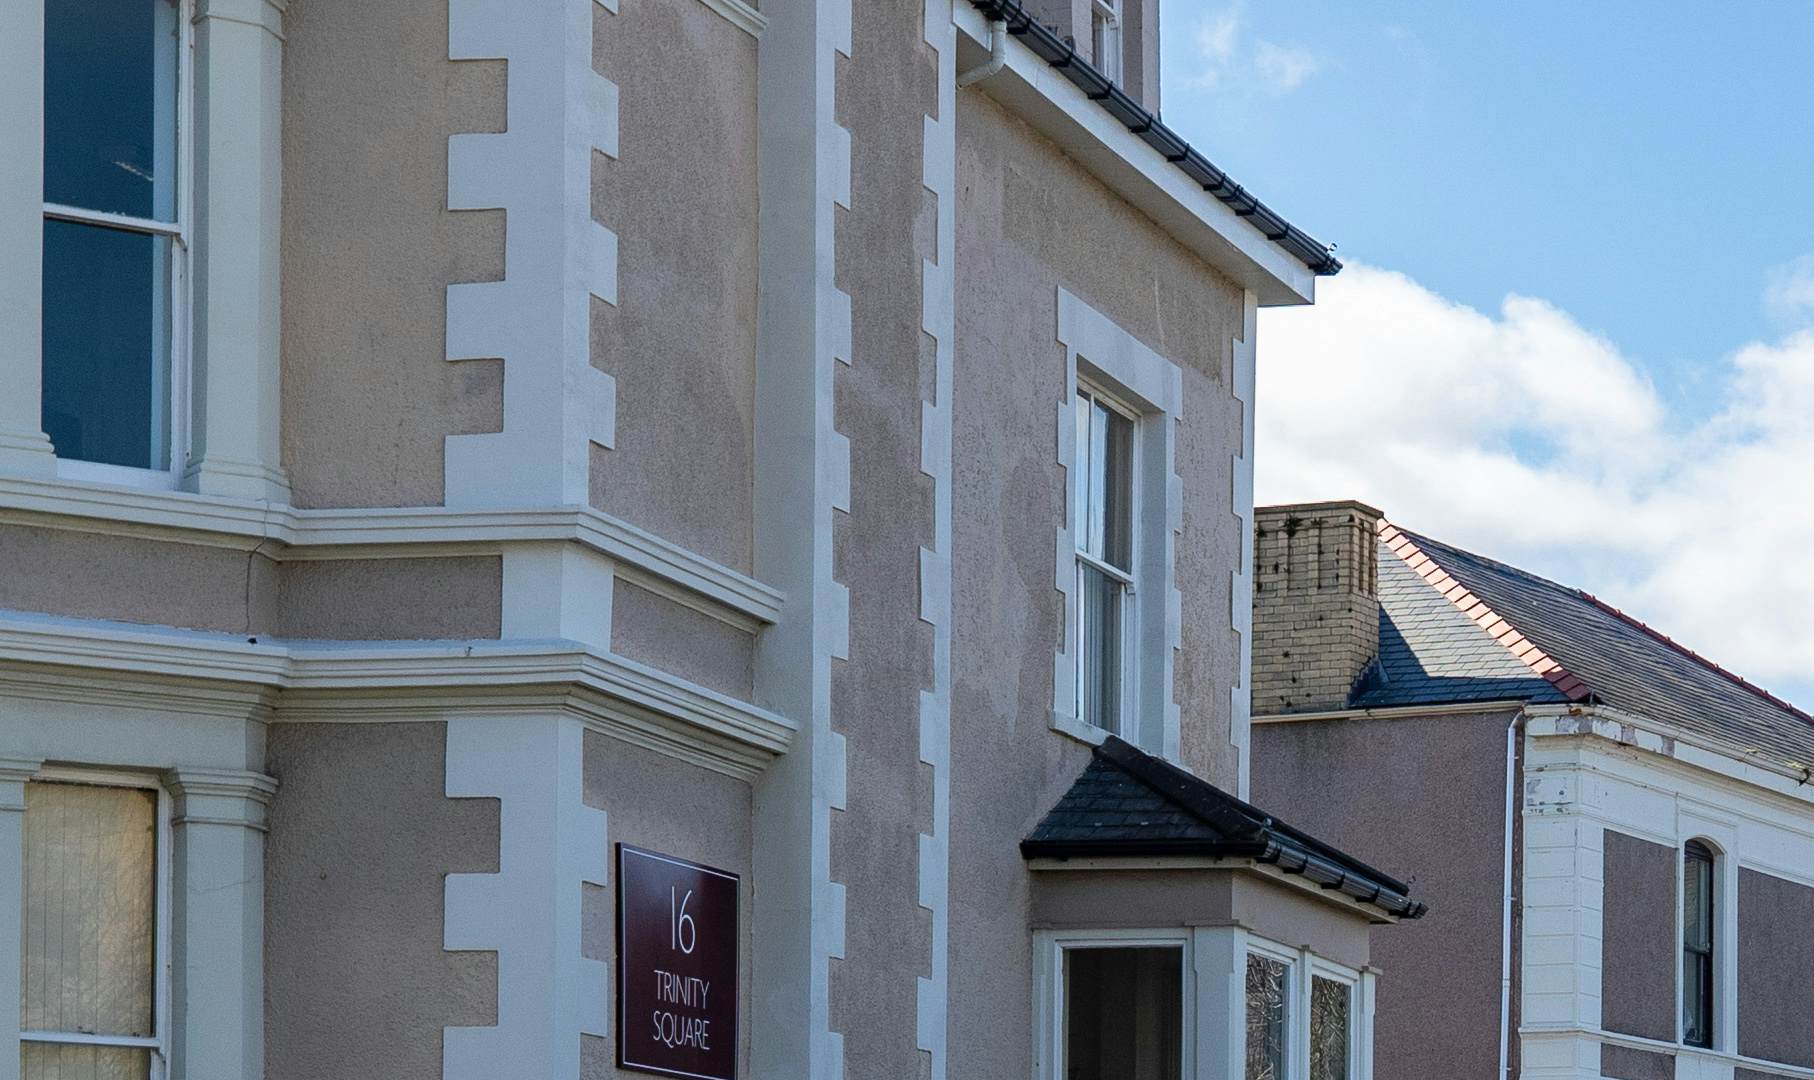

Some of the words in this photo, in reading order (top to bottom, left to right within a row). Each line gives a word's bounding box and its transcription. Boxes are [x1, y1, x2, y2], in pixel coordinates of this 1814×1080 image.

[671, 886, 696, 954] 16
[653, 969, 710, 1009] TRINITY
[653, 1010, 711, 1051] SQUARE
